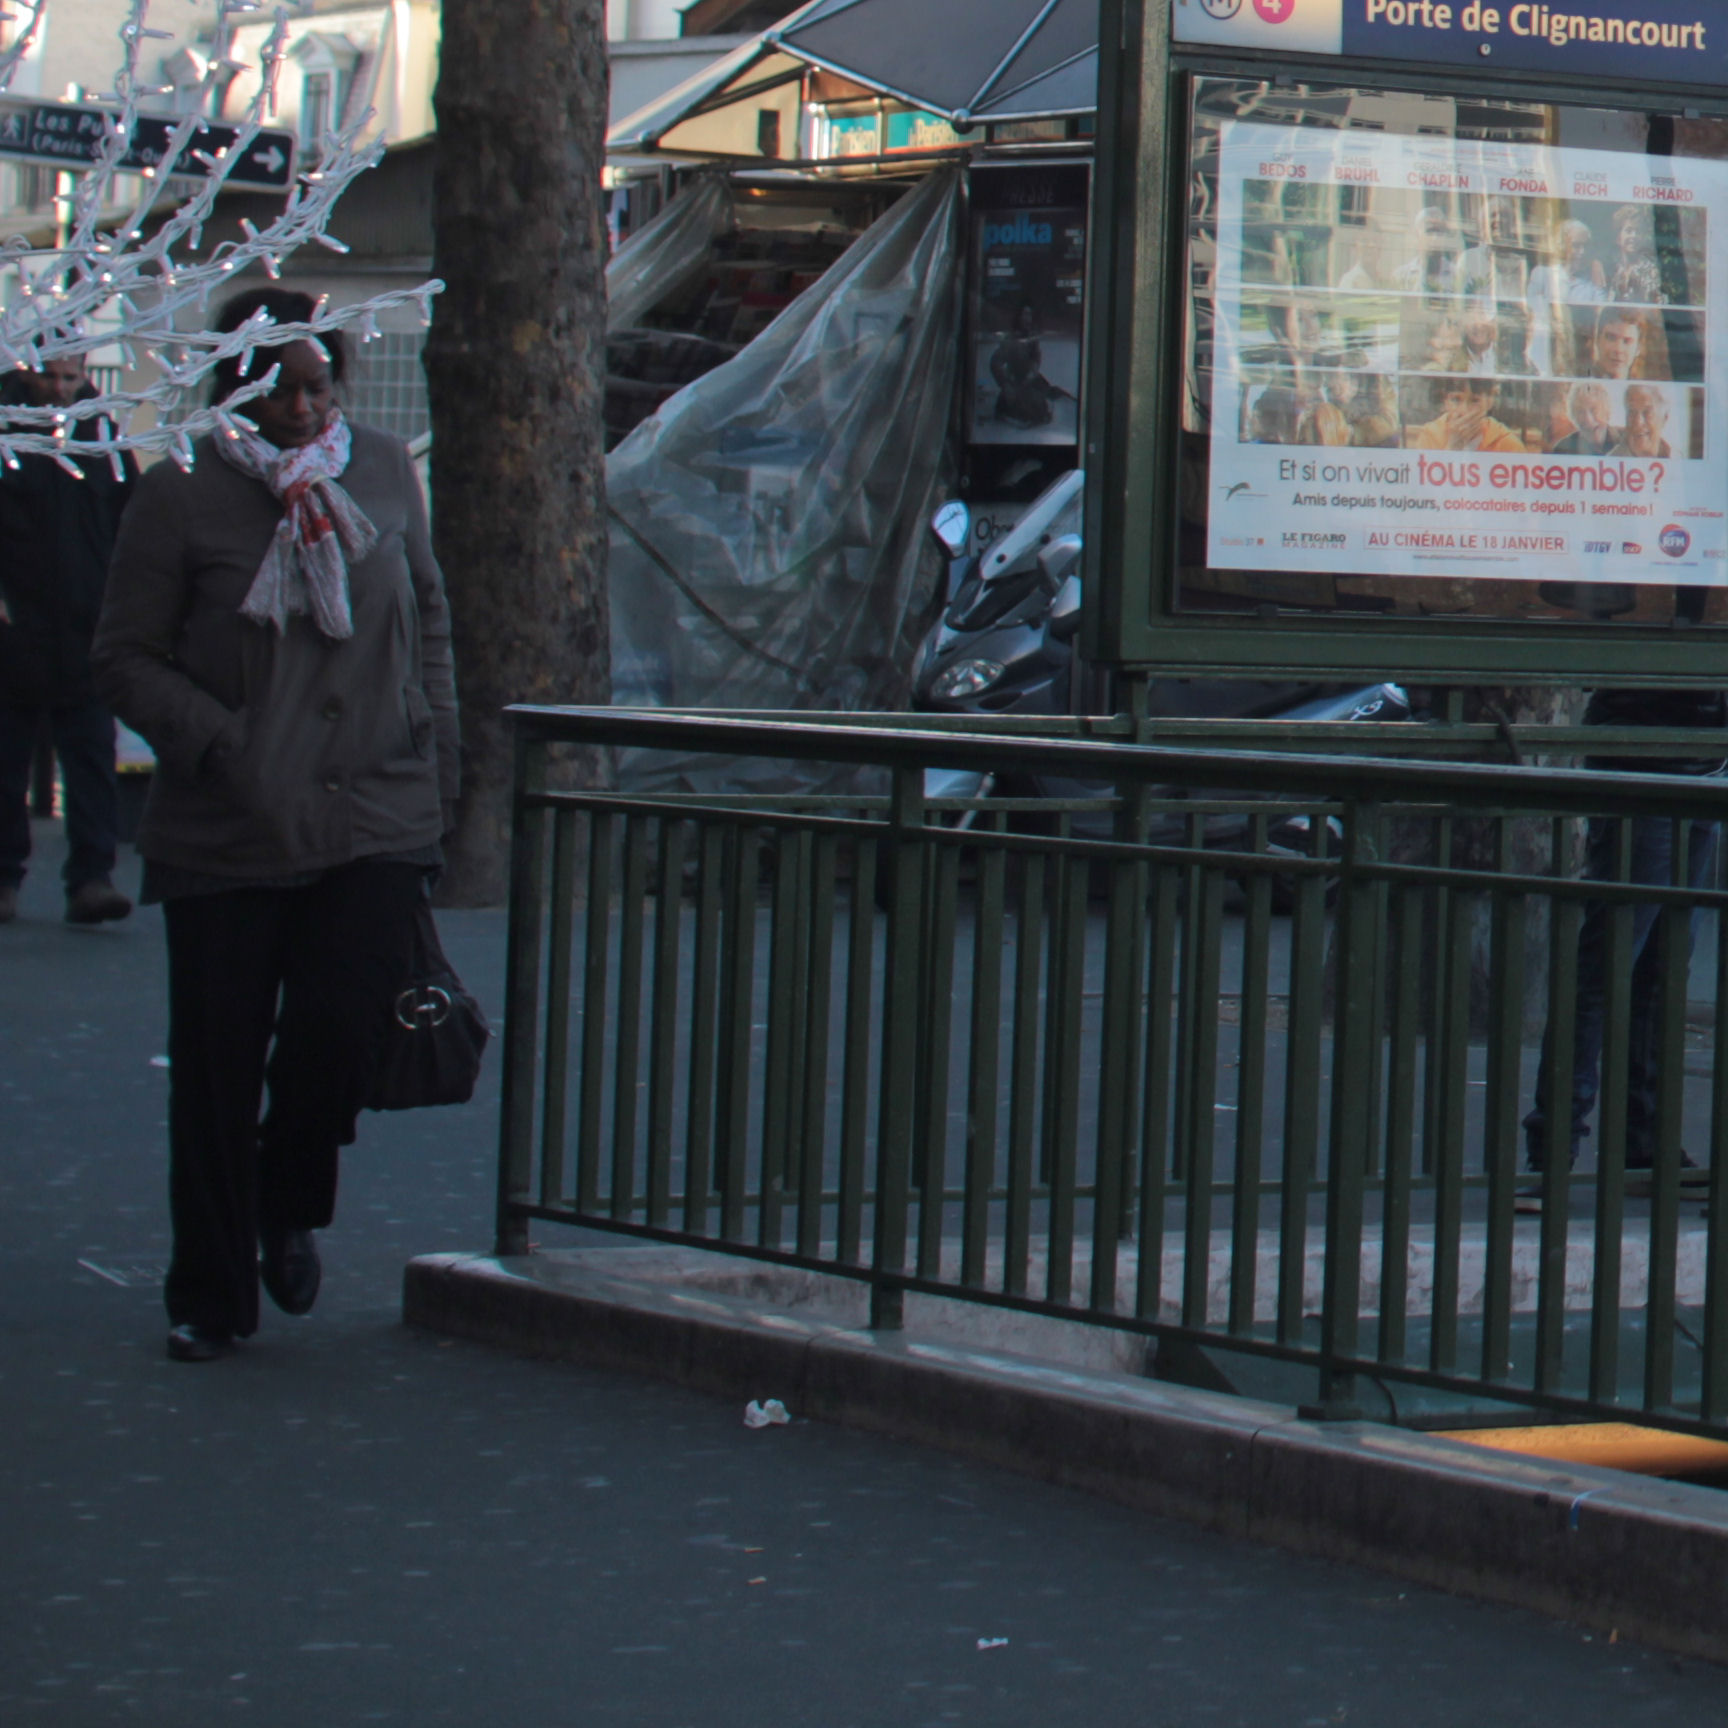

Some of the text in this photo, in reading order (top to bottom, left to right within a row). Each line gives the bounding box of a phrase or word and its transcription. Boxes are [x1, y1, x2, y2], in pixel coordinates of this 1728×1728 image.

[1461, 0, 1500, 33] de
[1509, 4, 1706, 50] Clignancourt
[1259, 162, 1307, 179] BEDOS
[1500, 177, 1549, 194] FONDA
[1573, 182, 1608, 197] RICH
[1632, 185, 1694, 202] RICHARD
[983, 213, 1052, 251] polka
[1279, 458, 1296, 481] Et
[1303, 460, 1316, 482] si
[1322, 464, 1350, 483] on
[1356, 462, 1410, 485] vivait
[1418, 454, 1480, 487] tous
[1293, 493, 1327, 507] Amis
[1331, 493, 1376, 511] depuis
[1380, 495, 1440, 512] toujours,
[1443, 496, 1526, 513] colocataires
[1530, 499, 1575, 516] depuis
[1580, 501, 1586, 514] 1
[1282, 531, 1346, 544] LE FIGARO
[1282, 541, 1346, 550] MAGAZINE
[1368, 529, 1565, 551] AU CINÉMA LE 18 JANVIER
